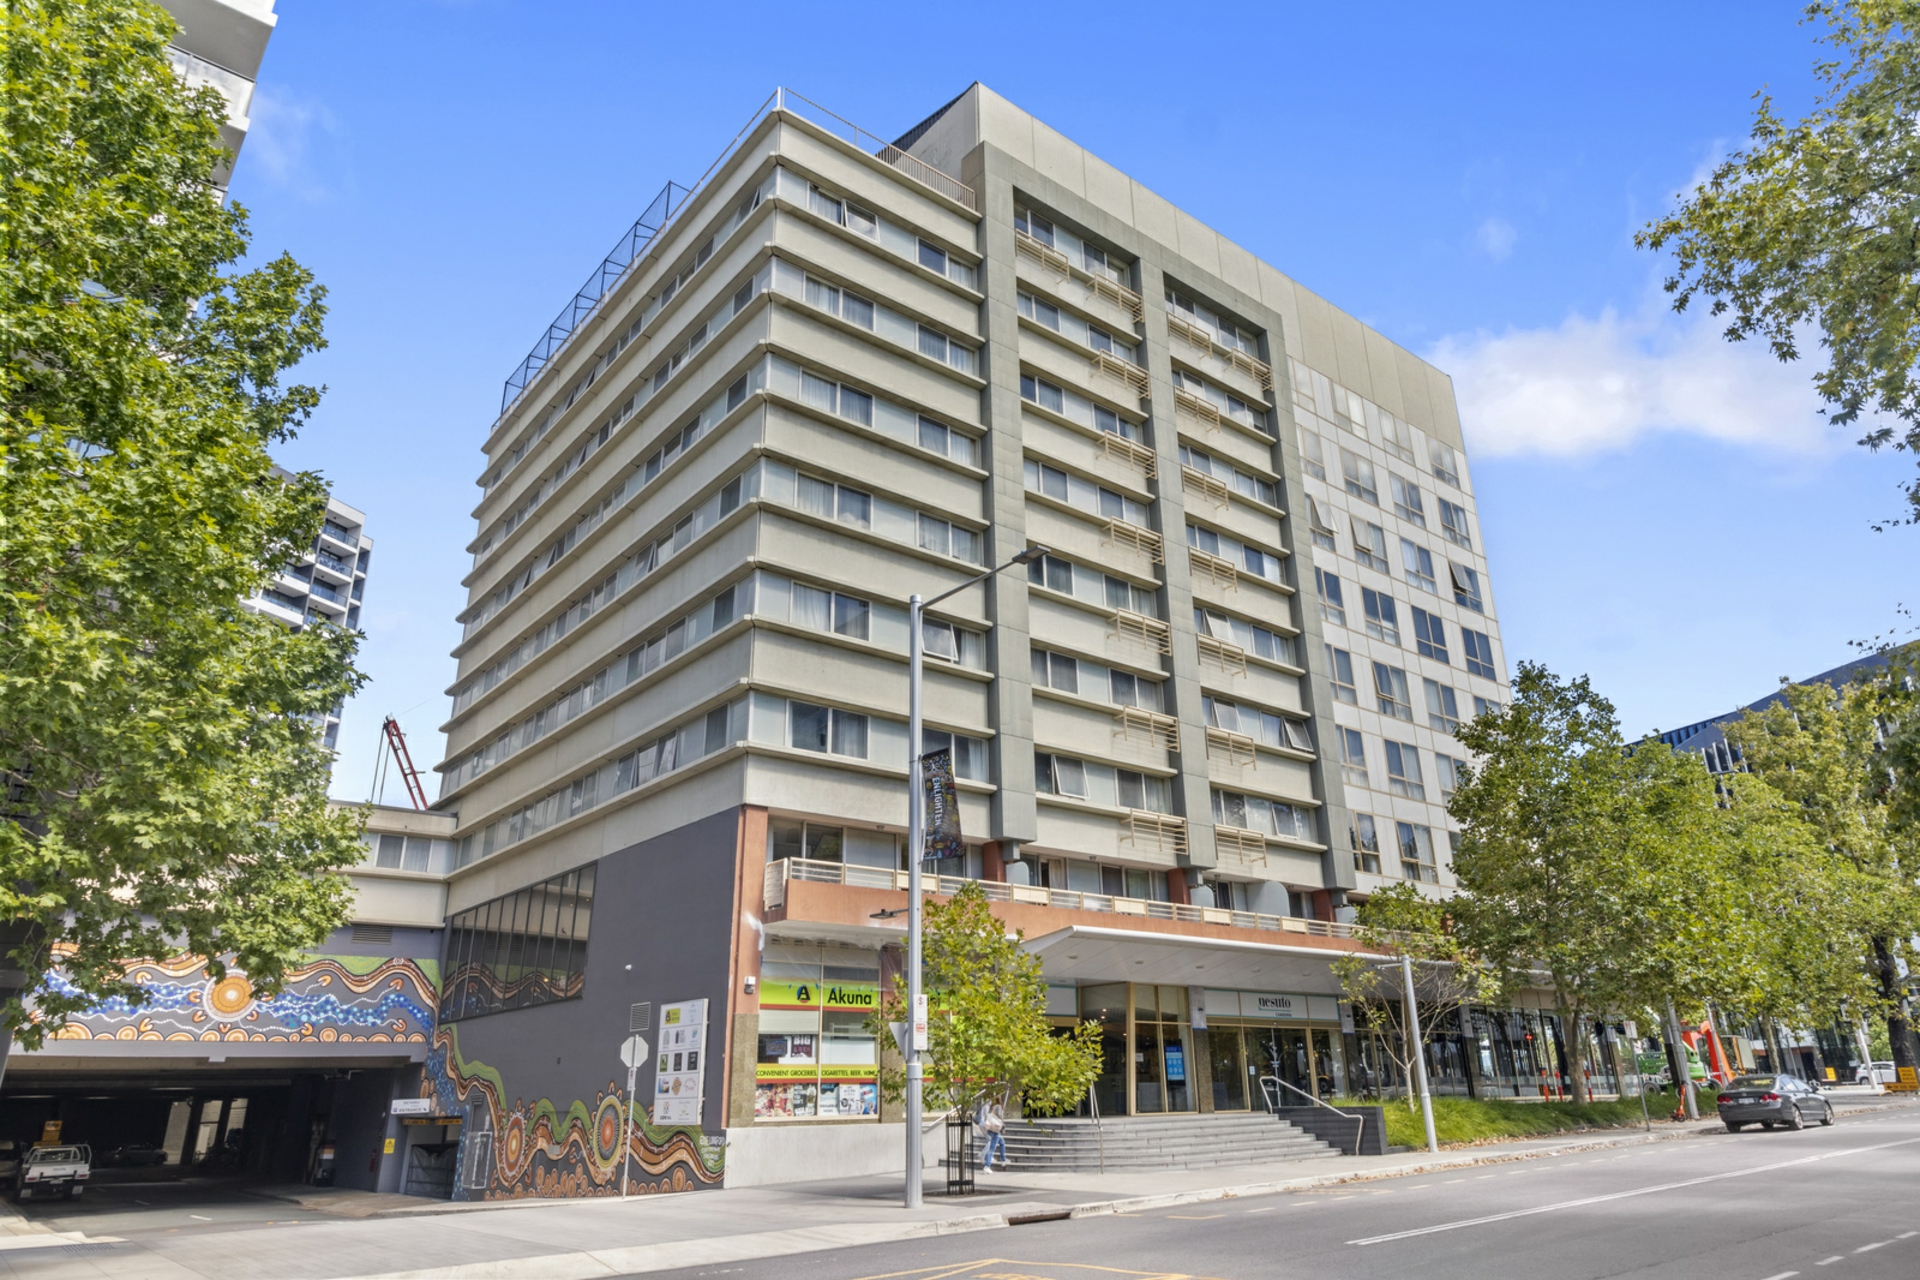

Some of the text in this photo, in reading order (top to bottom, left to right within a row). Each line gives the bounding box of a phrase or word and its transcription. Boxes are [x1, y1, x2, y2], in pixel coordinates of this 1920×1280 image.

[932, 776, 943, 826] ENLIGHTEN
[827, 987, 872, 1005] Akuna
[1258, 996, 1291, 1009] nesuto
